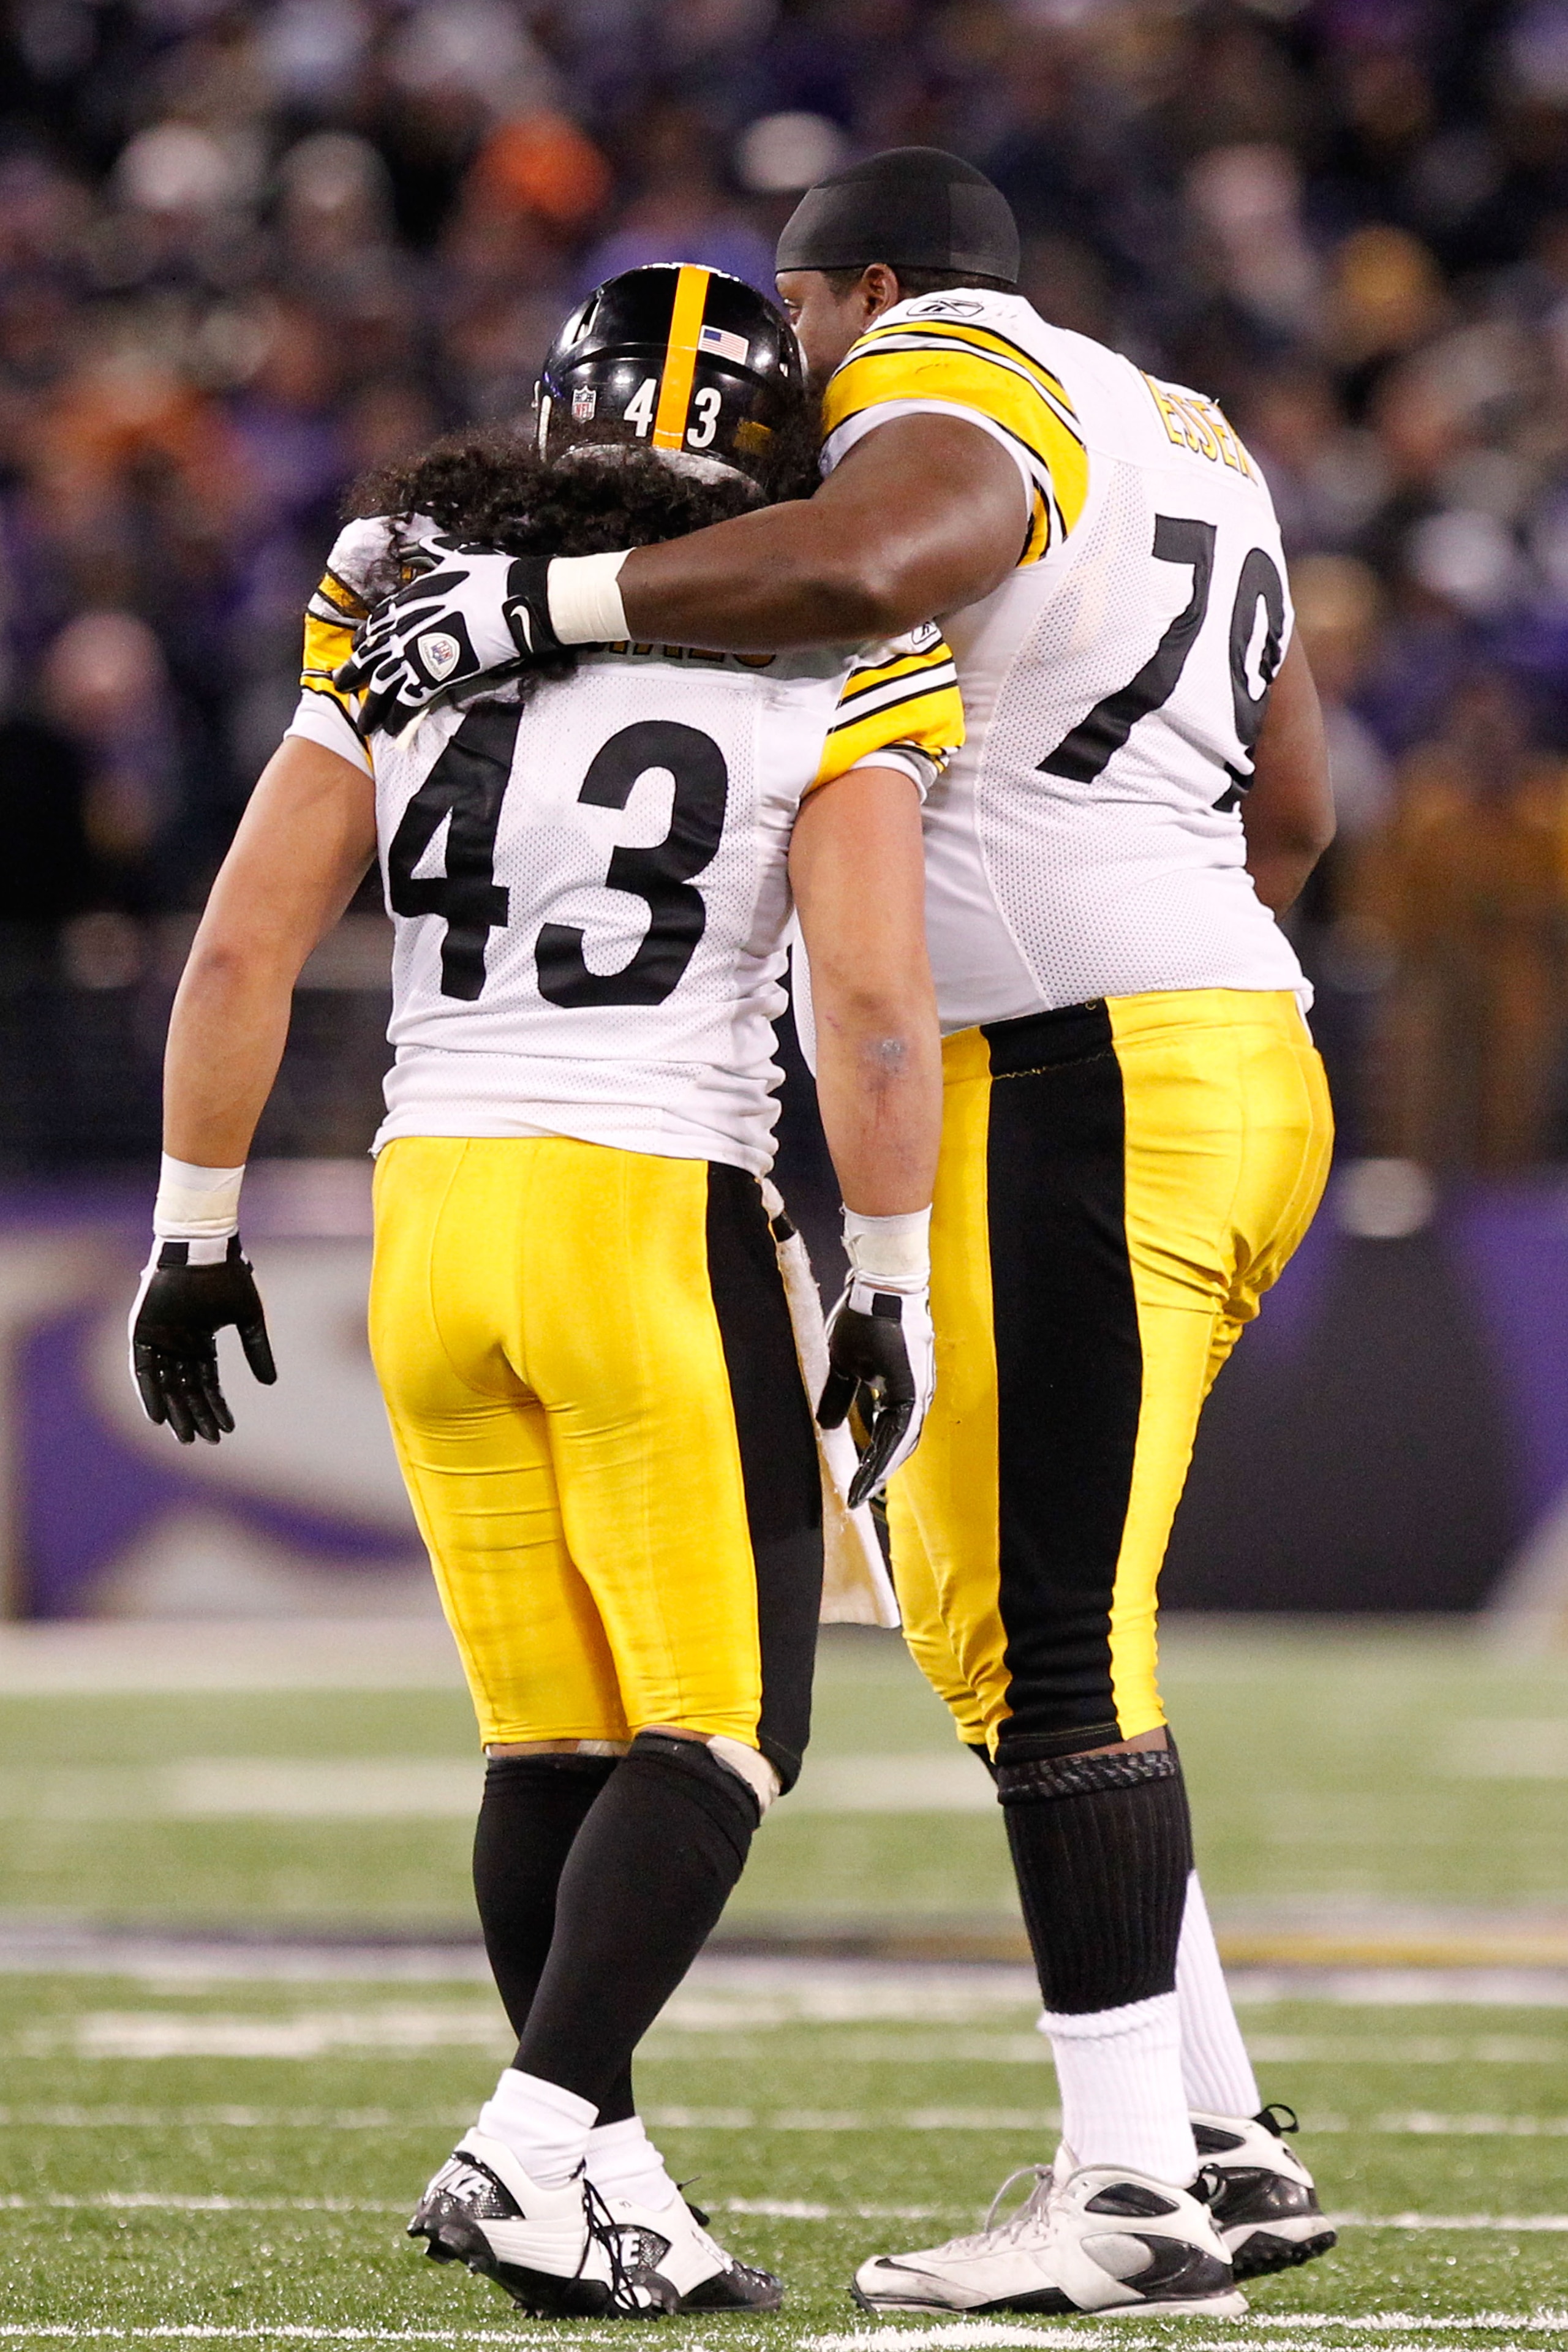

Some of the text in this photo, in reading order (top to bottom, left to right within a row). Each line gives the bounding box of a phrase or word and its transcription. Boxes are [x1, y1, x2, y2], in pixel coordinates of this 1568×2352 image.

[573, 402, 592, 419] NFL
[1035, 513, 1285, 813] 79
[388, 702, 728, 1008] 43
